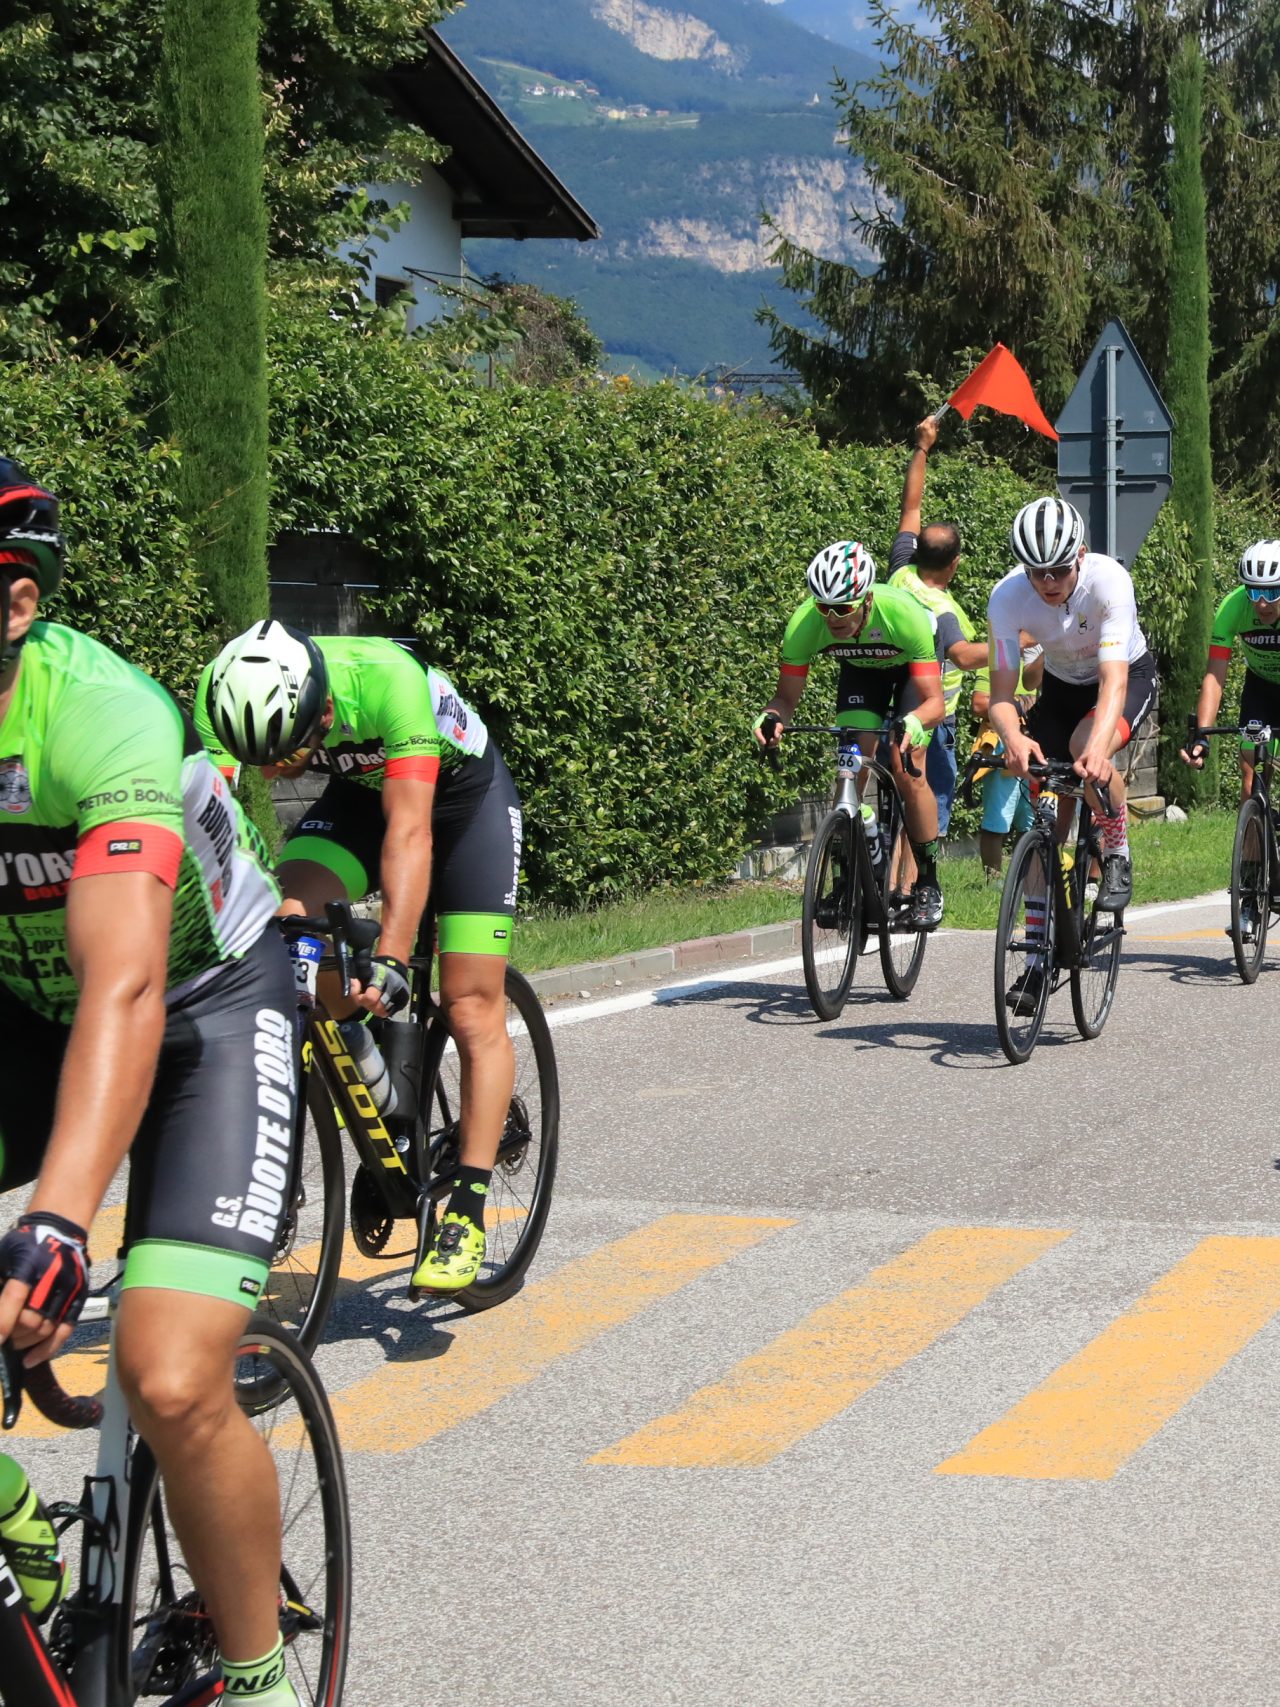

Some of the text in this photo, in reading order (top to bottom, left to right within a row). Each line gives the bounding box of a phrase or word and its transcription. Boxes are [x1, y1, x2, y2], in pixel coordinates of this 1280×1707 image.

[238, 1008, 291, 1243] RUOTE D'ORO
[314, 1020, 408, 1175] SCOTT
[211, 1195, 243, 1229] G.S.
